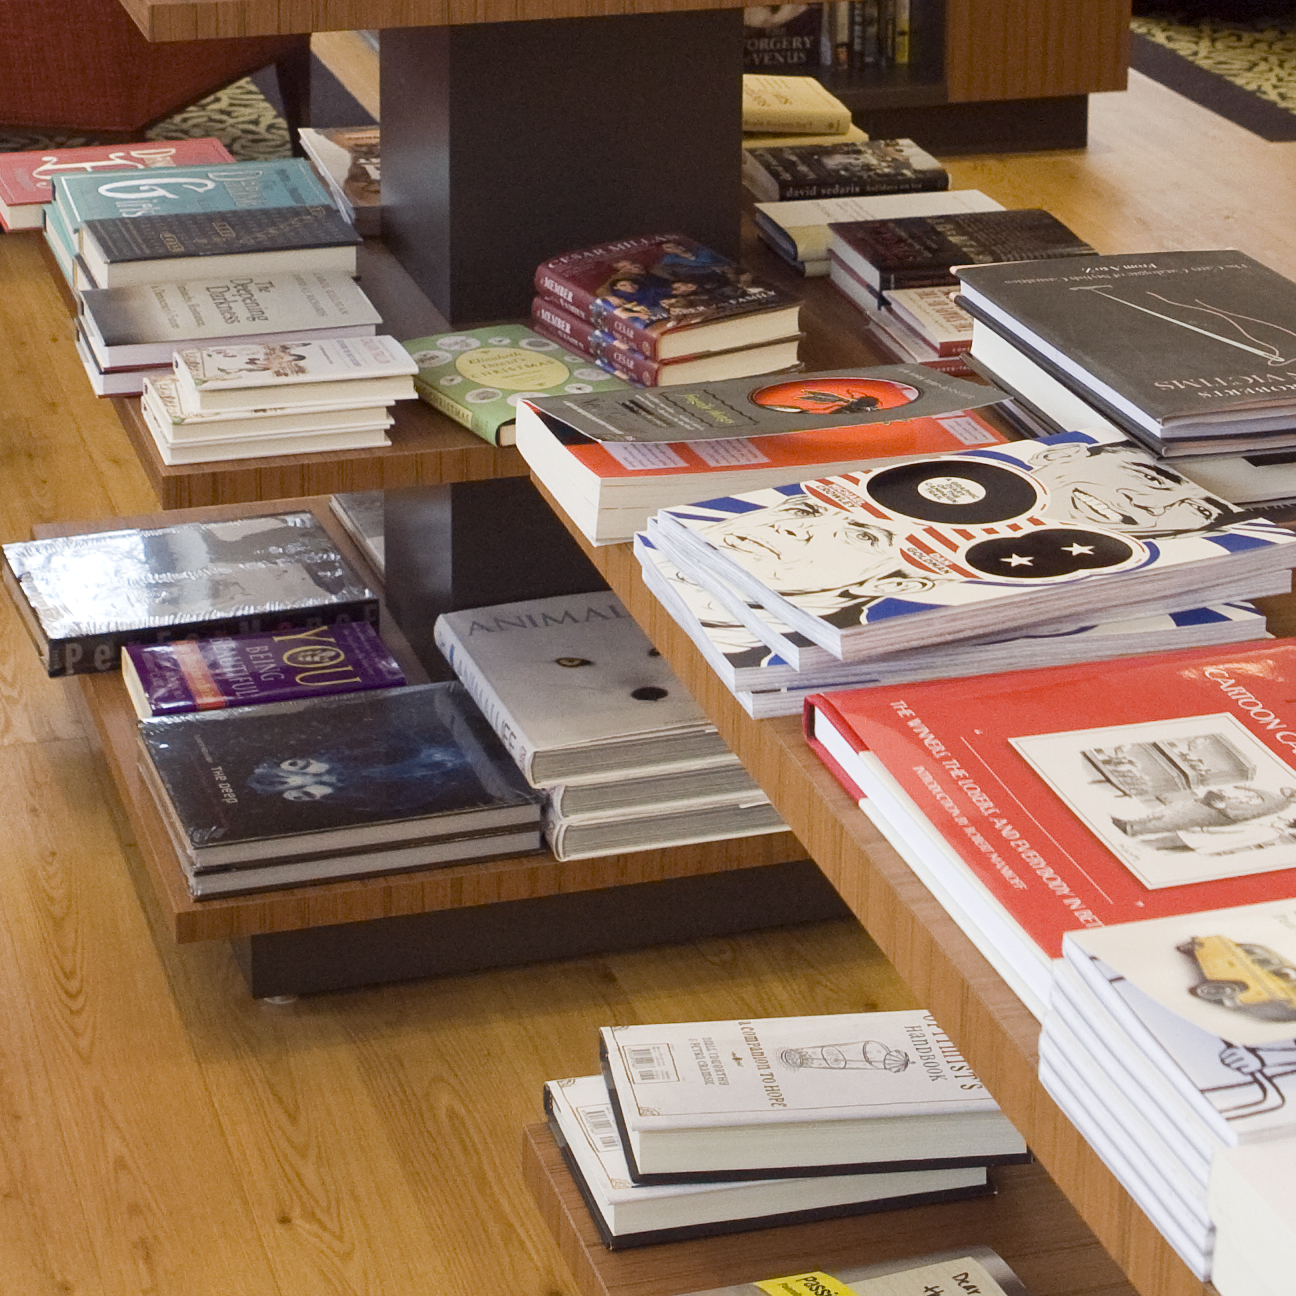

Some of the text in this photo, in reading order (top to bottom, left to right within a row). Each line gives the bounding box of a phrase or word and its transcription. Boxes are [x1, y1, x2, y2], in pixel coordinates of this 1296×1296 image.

[786, 184, 861, 199] david sedaris
[206, 286, 240, 325] Darkness
[230, 278, 269, 322] Deepening
[543, 276, 574, 303] MEMBER
[209, 637, 260, 699] BEAUTIFUL
[246, 645, 285, 682] BEING
[273, 625, 361, 687] YOU
[1203, 667, 1287, 733] CARTOON
